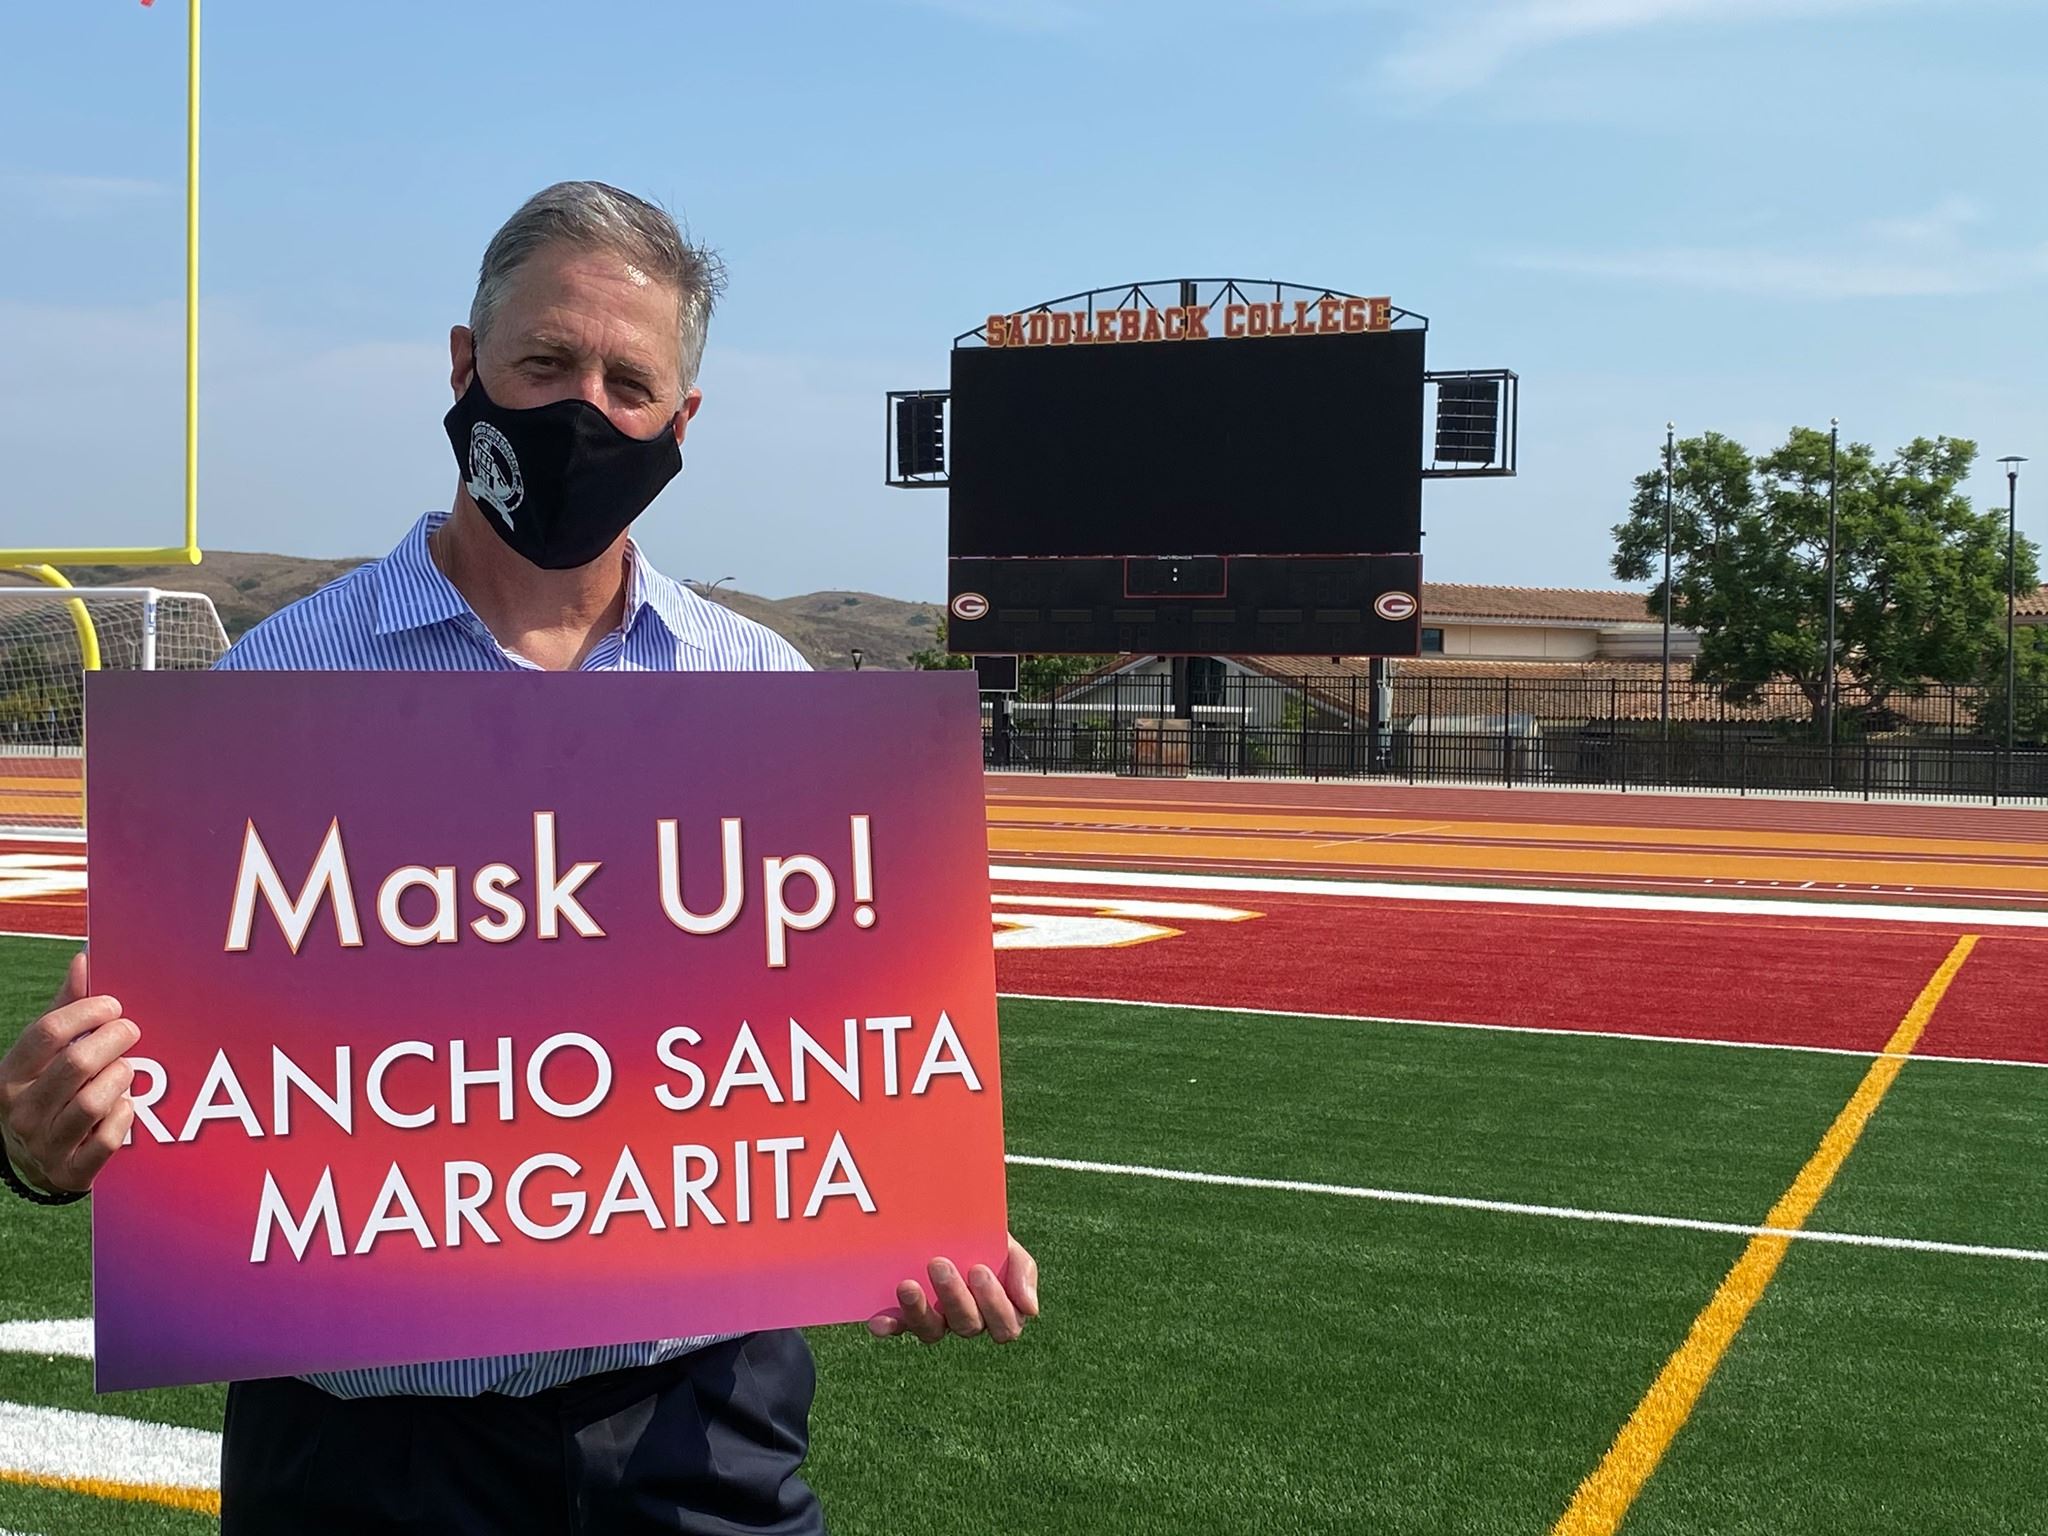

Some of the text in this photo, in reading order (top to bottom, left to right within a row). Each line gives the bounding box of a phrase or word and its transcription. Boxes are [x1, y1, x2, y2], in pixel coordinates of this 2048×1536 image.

[985, 296, 1392, 348] SADDLEBACK COLLEGE
[954, 594, 987, 618] G
[1377, 593, 1414, 619] G
[224, 811, 877, 968] Mask Up!
[121, 1009, 983, 1146] RANCHO SANTA
[250, 1129, 877, 1264] MARGARITA
